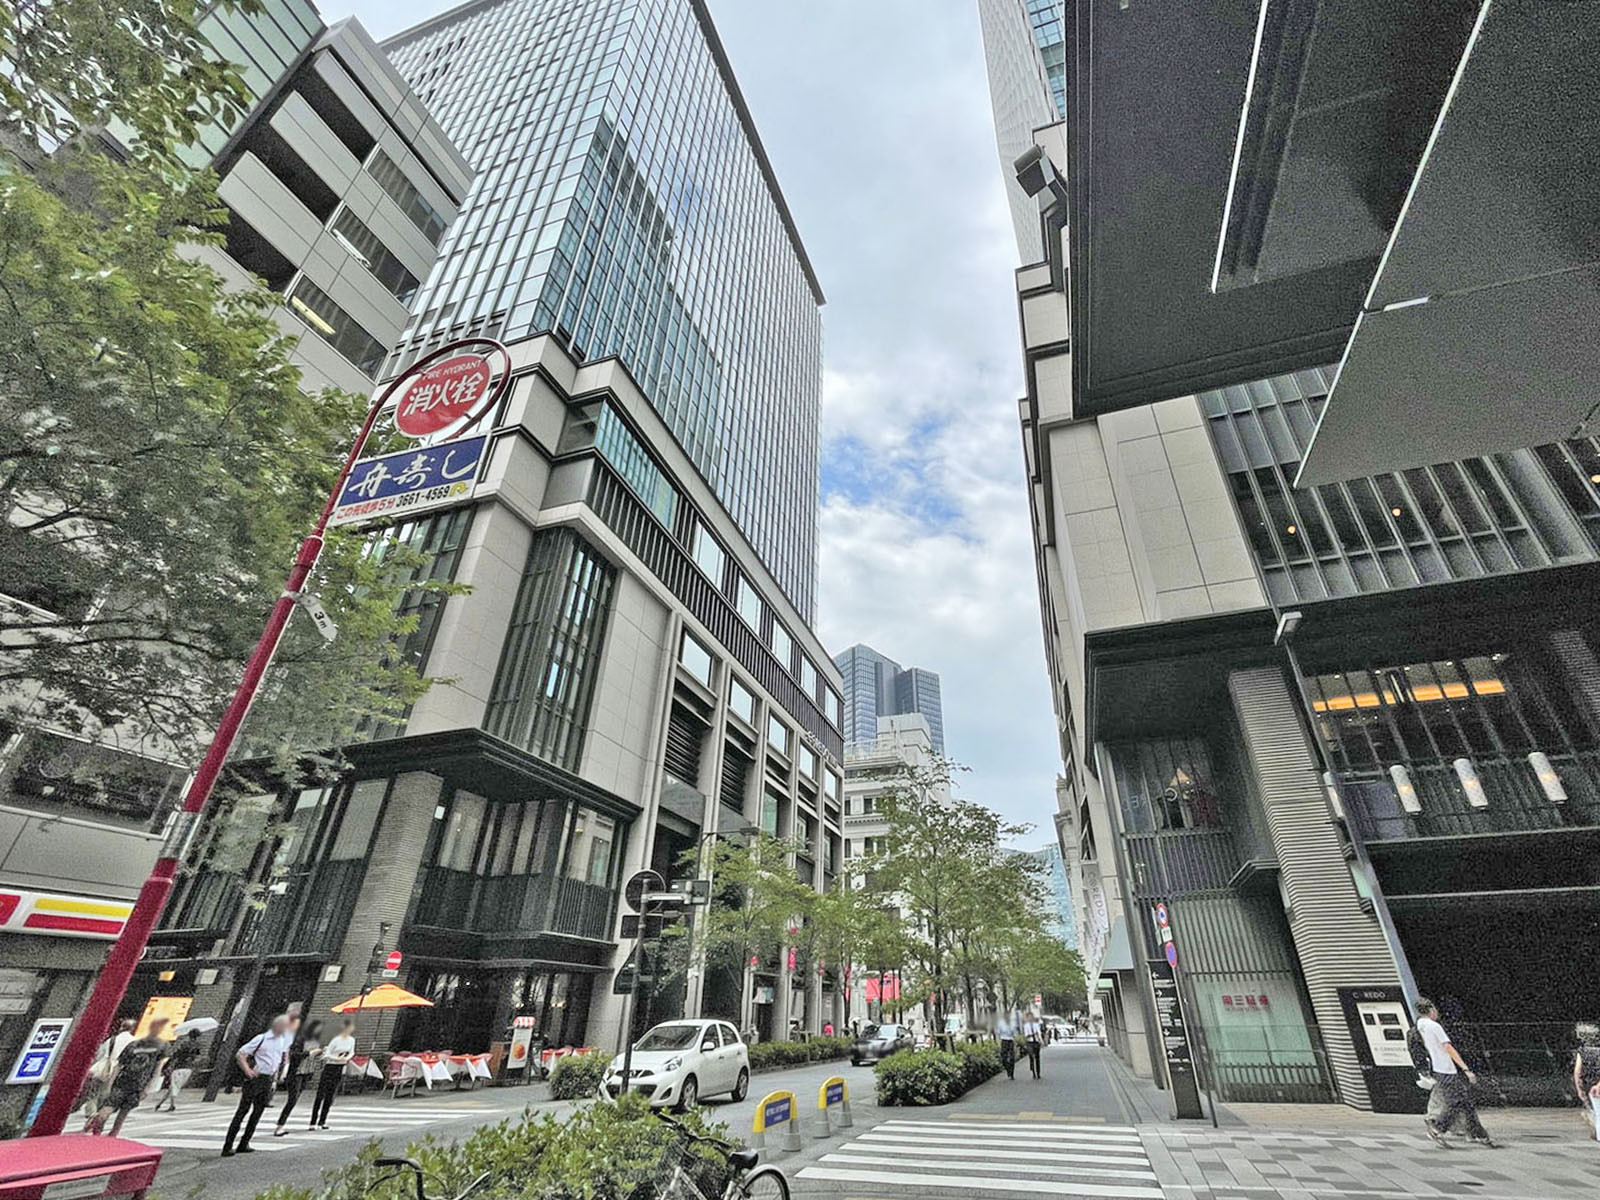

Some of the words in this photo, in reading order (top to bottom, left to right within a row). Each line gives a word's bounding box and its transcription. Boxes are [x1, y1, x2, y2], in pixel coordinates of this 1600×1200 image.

[442, 359, 482, 377] HYDRANT
[402, 372, 485, 418] 消火栓
